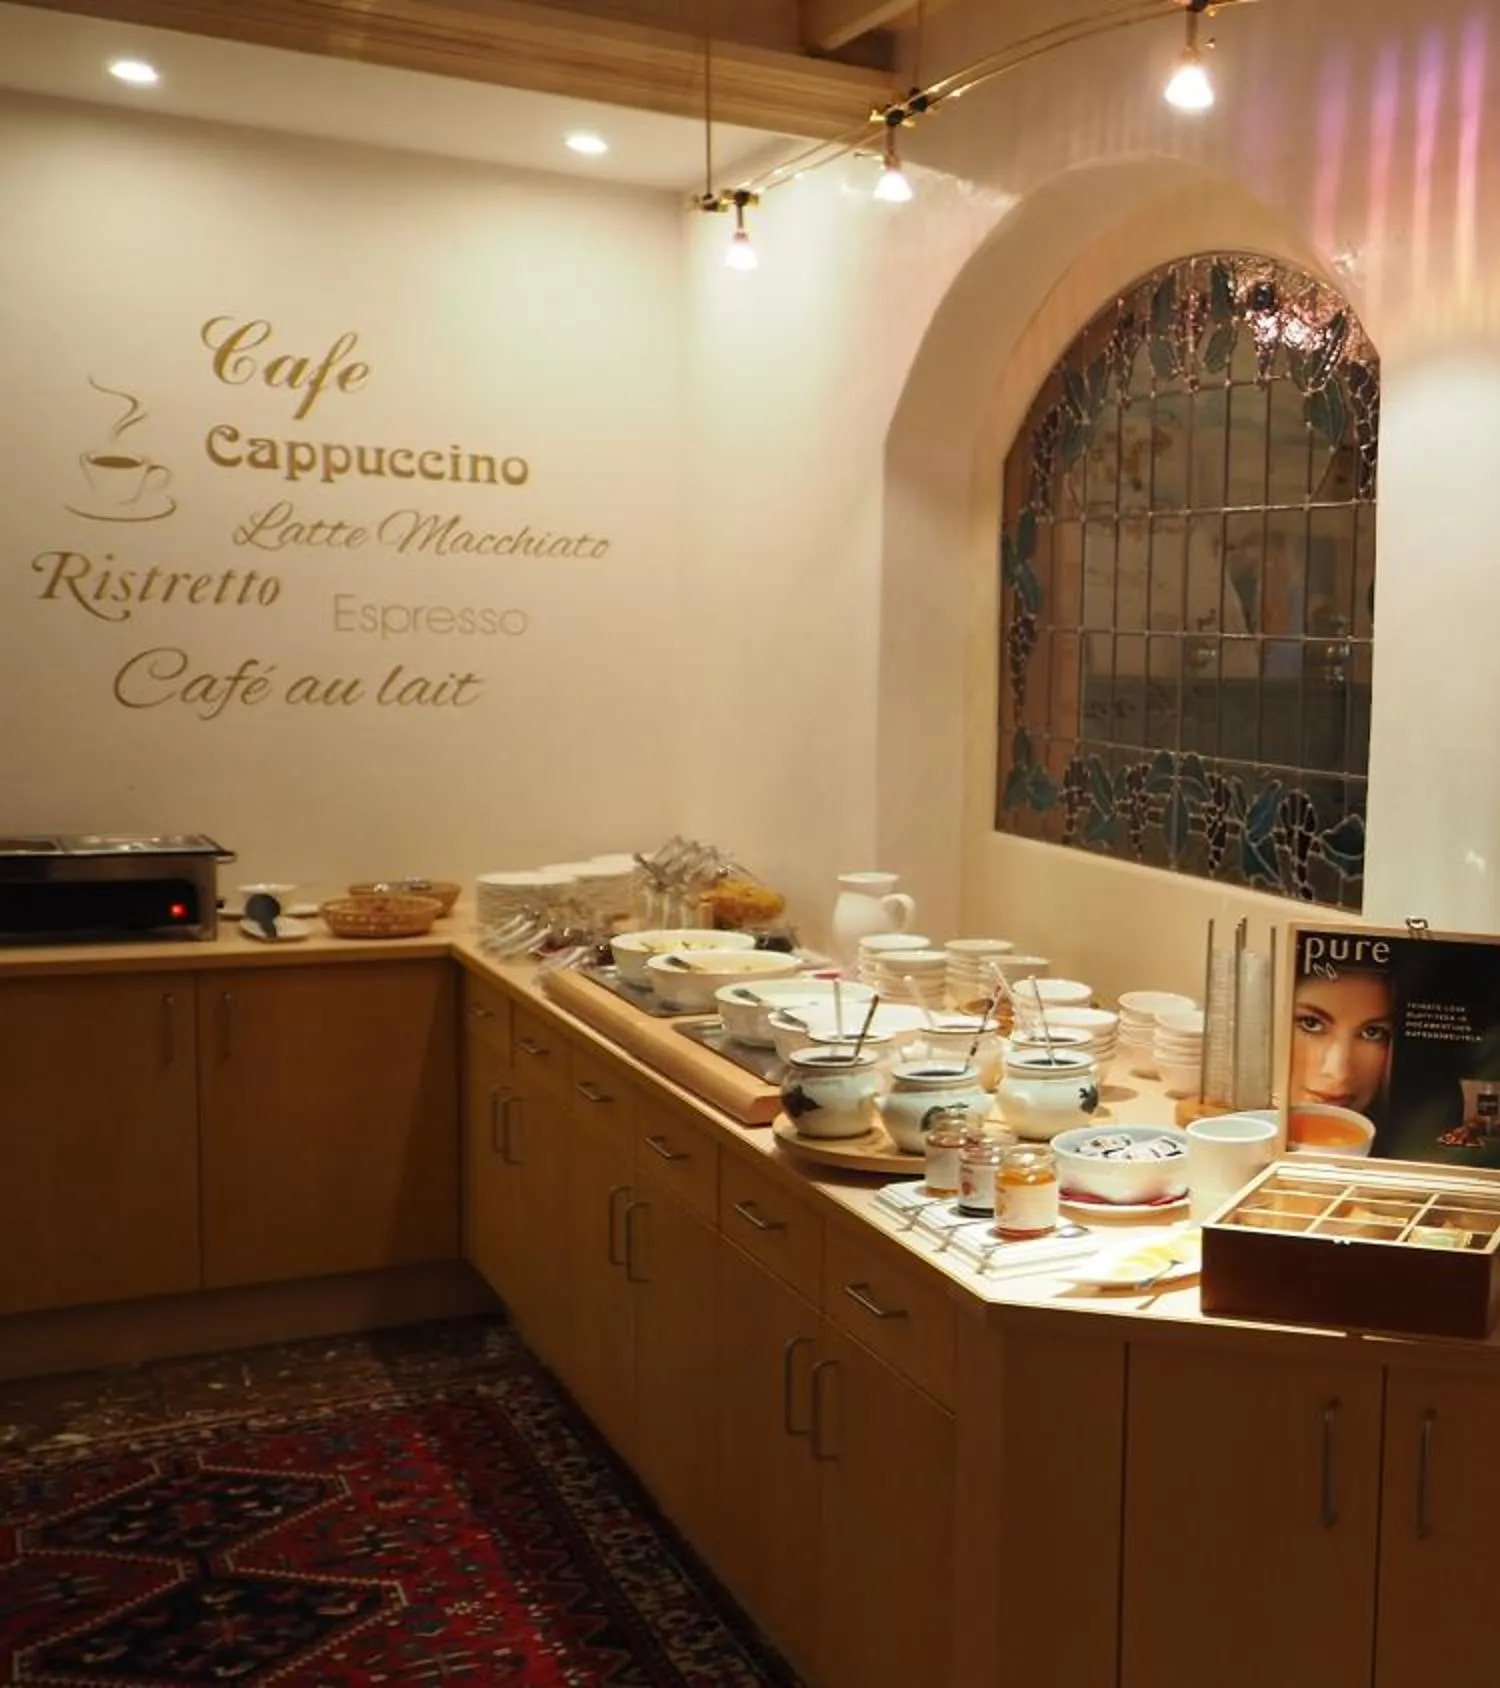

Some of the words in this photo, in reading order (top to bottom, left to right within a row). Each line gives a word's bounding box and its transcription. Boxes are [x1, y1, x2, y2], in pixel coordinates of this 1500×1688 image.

[201, 315, 370, 420] Cafe
[205, 423, 530, 486] Cappuccino
[232, 501, 369, 551] Latte
[376, 509, 611, 560] Macchiato
[31, 550, 281, 623] Ristretto
[333, 593, 530, 640] Espresso
[113, 646, 274, 721] Café
[284, 668, 365, 707] au
[376, 664, 484, 707] lait
[1304, 937, 1391, 975] pure
